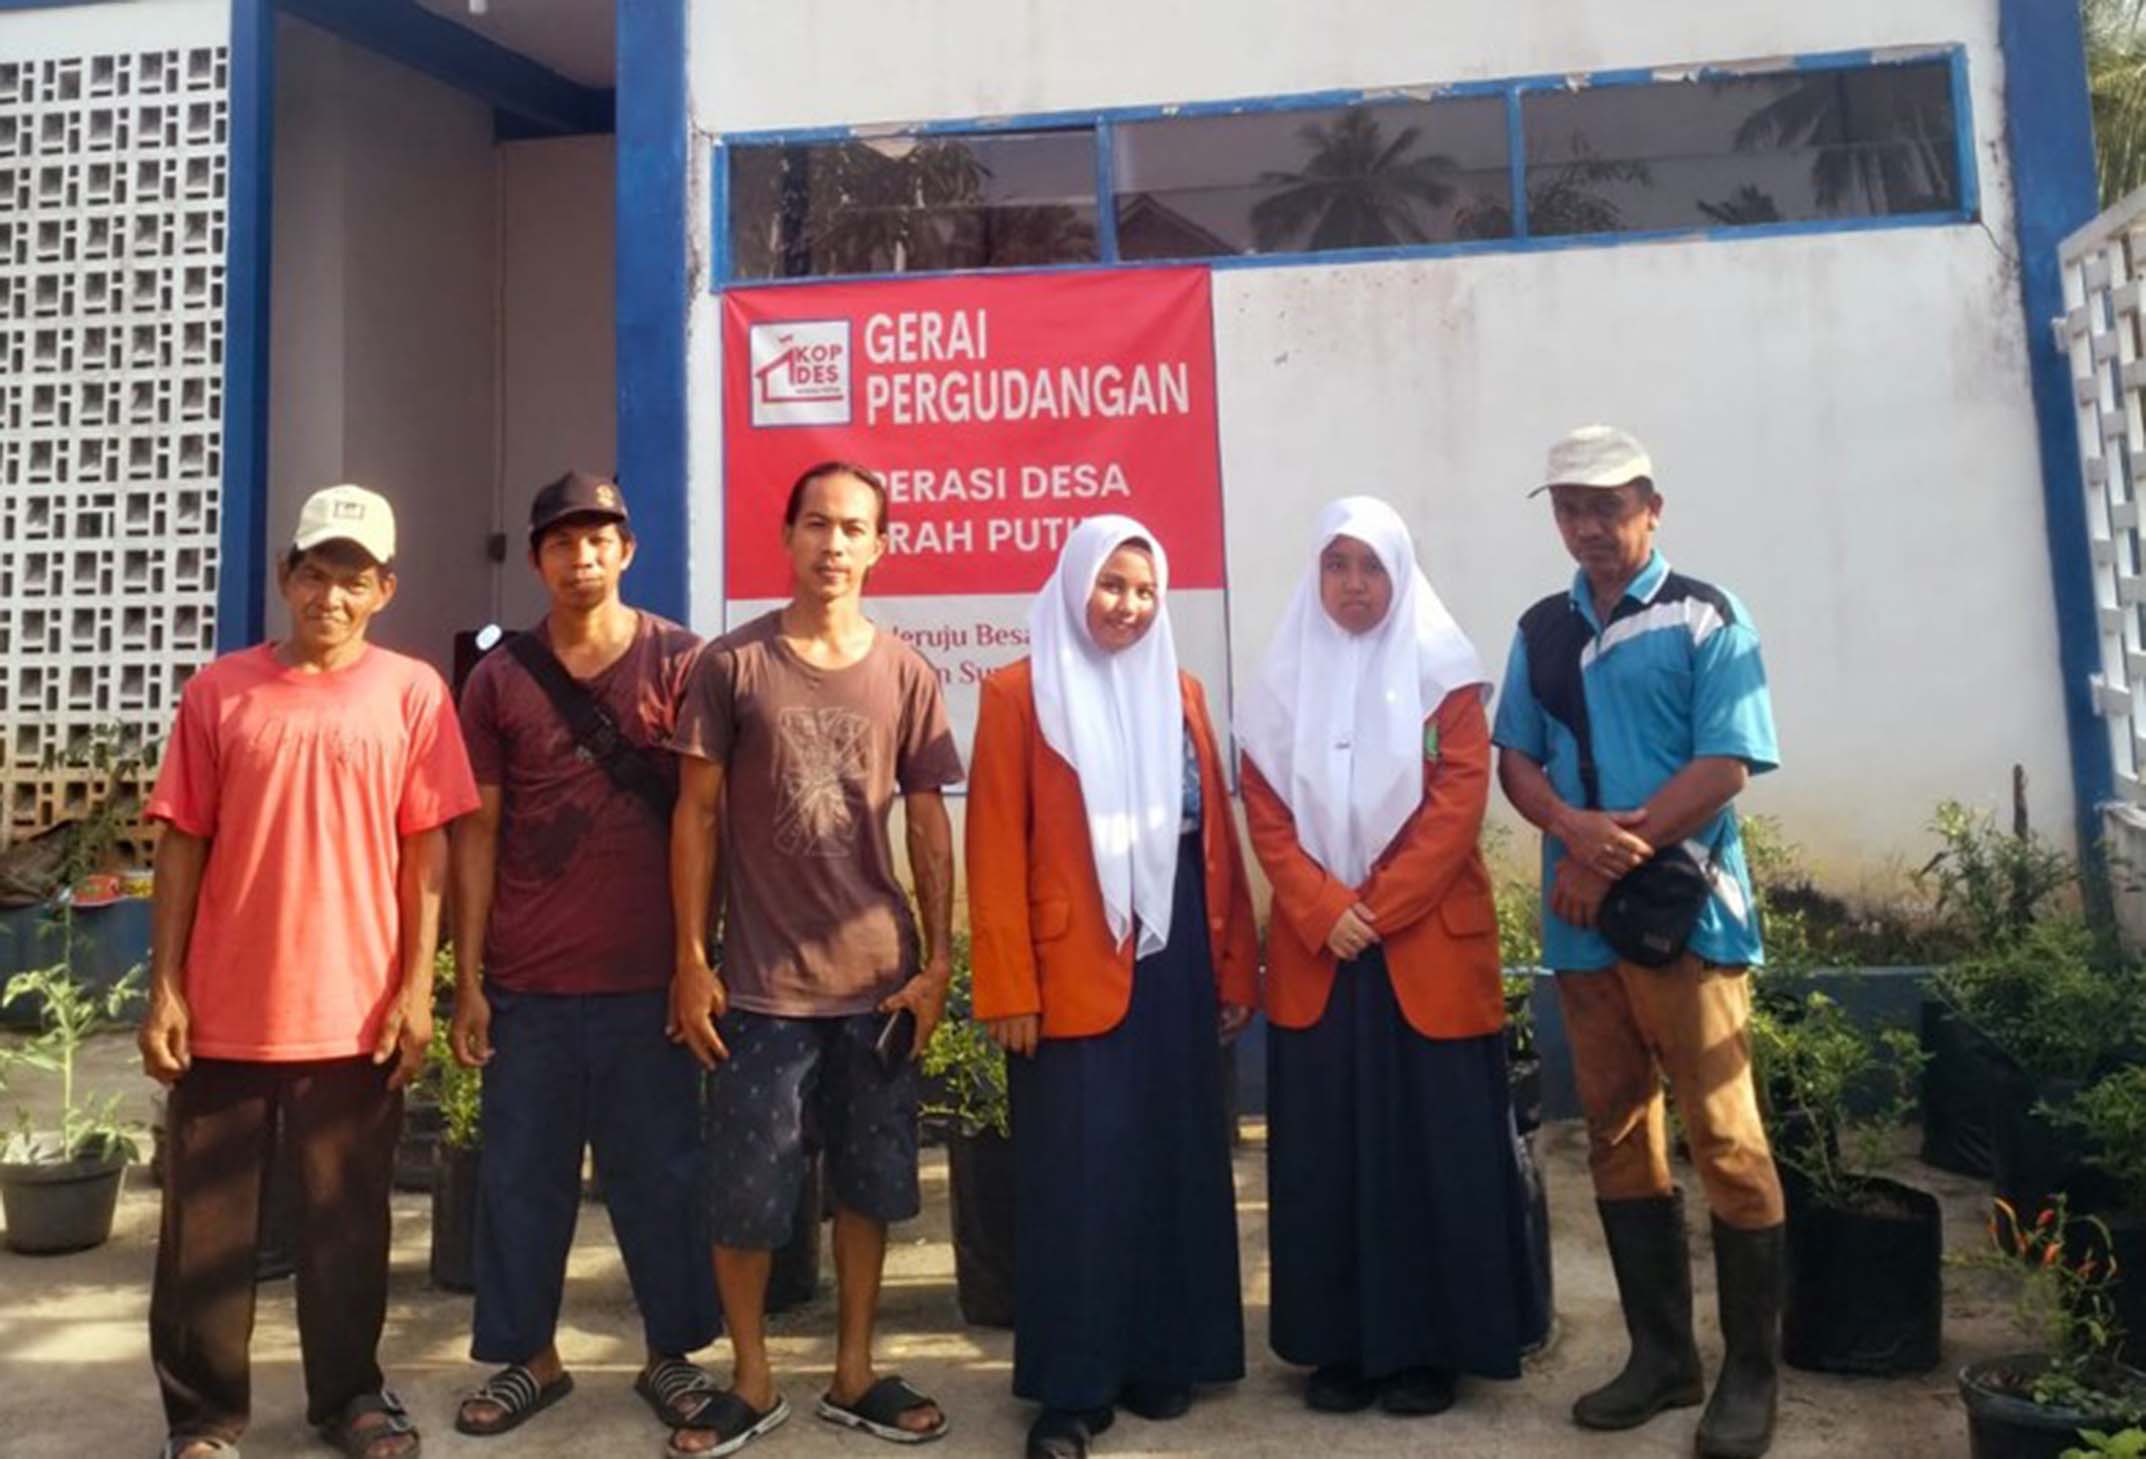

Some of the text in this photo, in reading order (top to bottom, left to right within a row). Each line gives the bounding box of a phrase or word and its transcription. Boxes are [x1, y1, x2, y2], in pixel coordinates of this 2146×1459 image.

[795, 344, 842, 363] KOP
[864, 309, 987, 363] GERAI
[797, 364, 838, 384] DES
[866, 363, 1190, 425] PERGUDANGAN
[1021, 463, 1131, 499] DESA
[887, 516, 1080, 554] RAH PUTI
[892, 624, 967, 651] eruju
